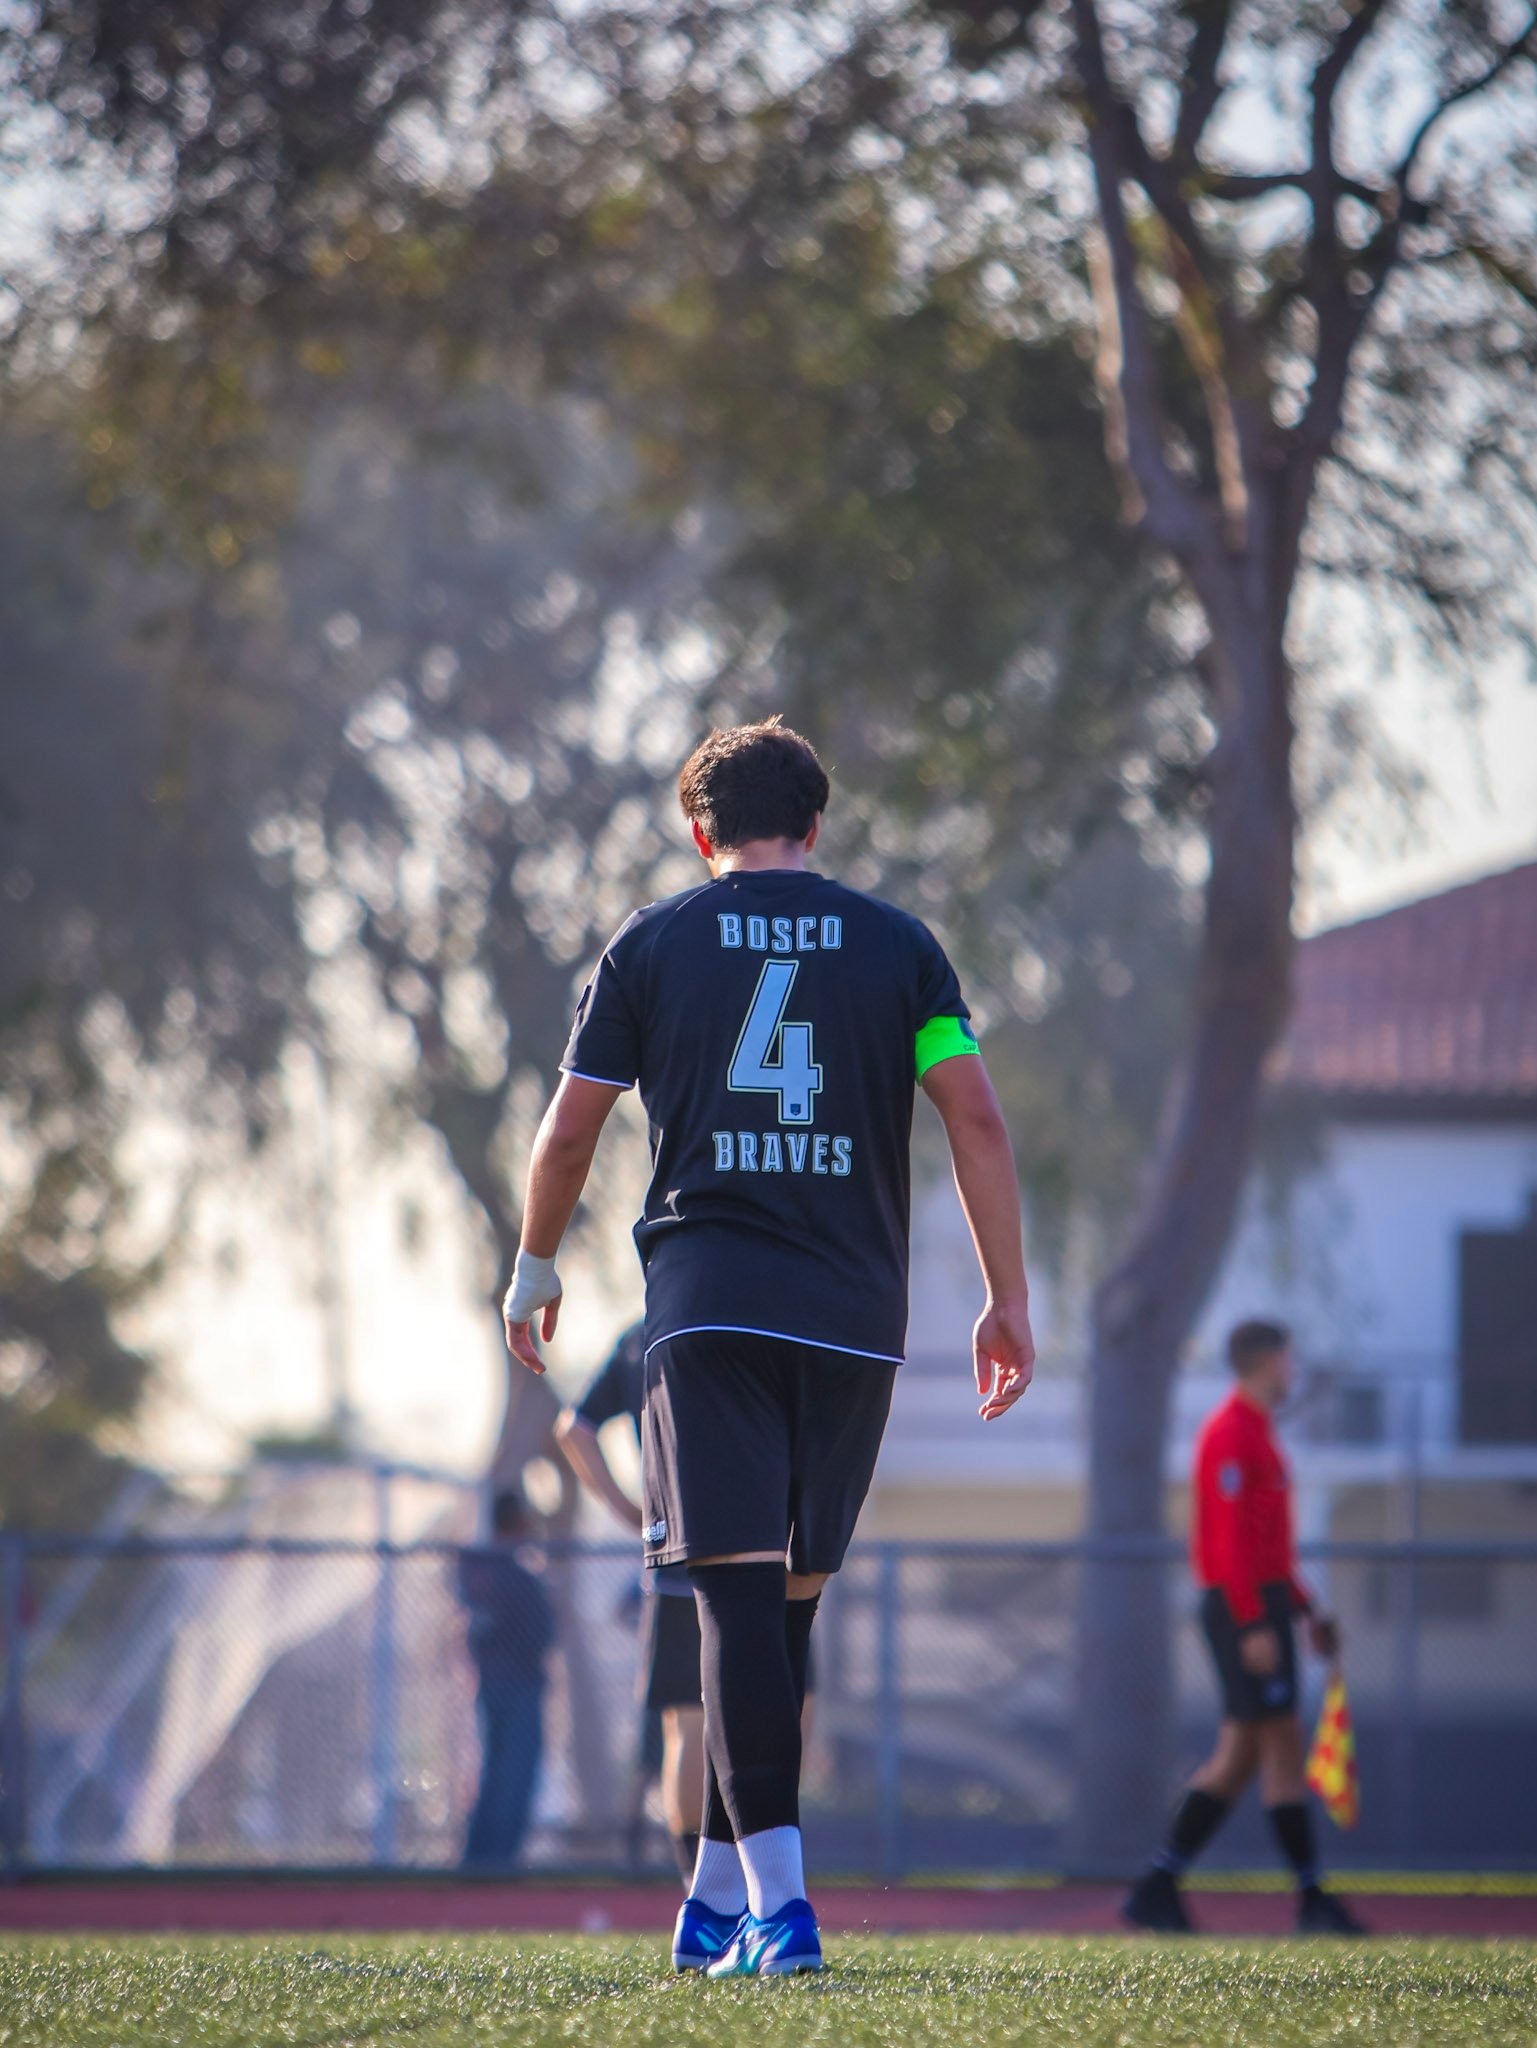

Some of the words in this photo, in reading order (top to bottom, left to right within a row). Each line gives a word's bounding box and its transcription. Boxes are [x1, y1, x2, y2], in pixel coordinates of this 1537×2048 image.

[717, 913, 843, 953] BOSCO
[727, 959, 824, 1125] 4
[712, 1131, 853, 1176] BRAVES
